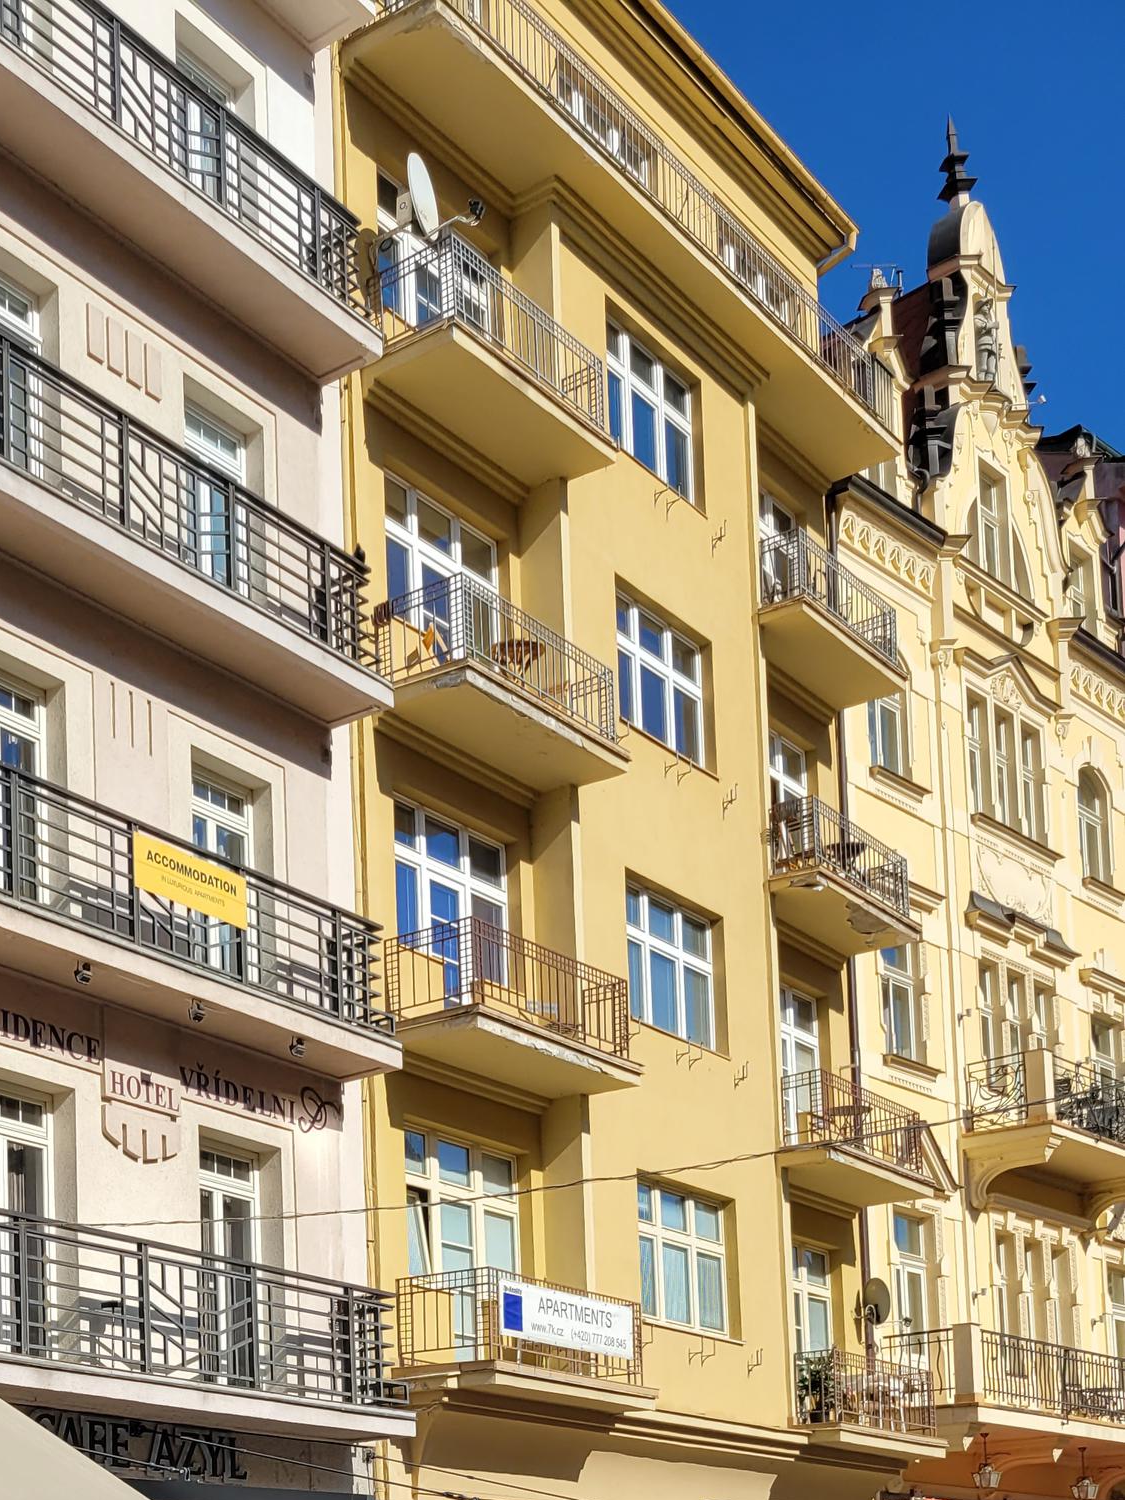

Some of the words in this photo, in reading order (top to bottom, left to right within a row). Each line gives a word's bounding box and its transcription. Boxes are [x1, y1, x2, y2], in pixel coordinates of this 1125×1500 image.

[146, 850, 237, 896] ACCOMMODATION
[109, 1069, 180, 1112] HOTEL
[538, 1296, 612, 1329] APARTMENTS
[530, 1321, 564, 1337] www.7k.cz
[571, 1328, 591, 1345] (+420)
[592, 1332, 603, 1344] 777
